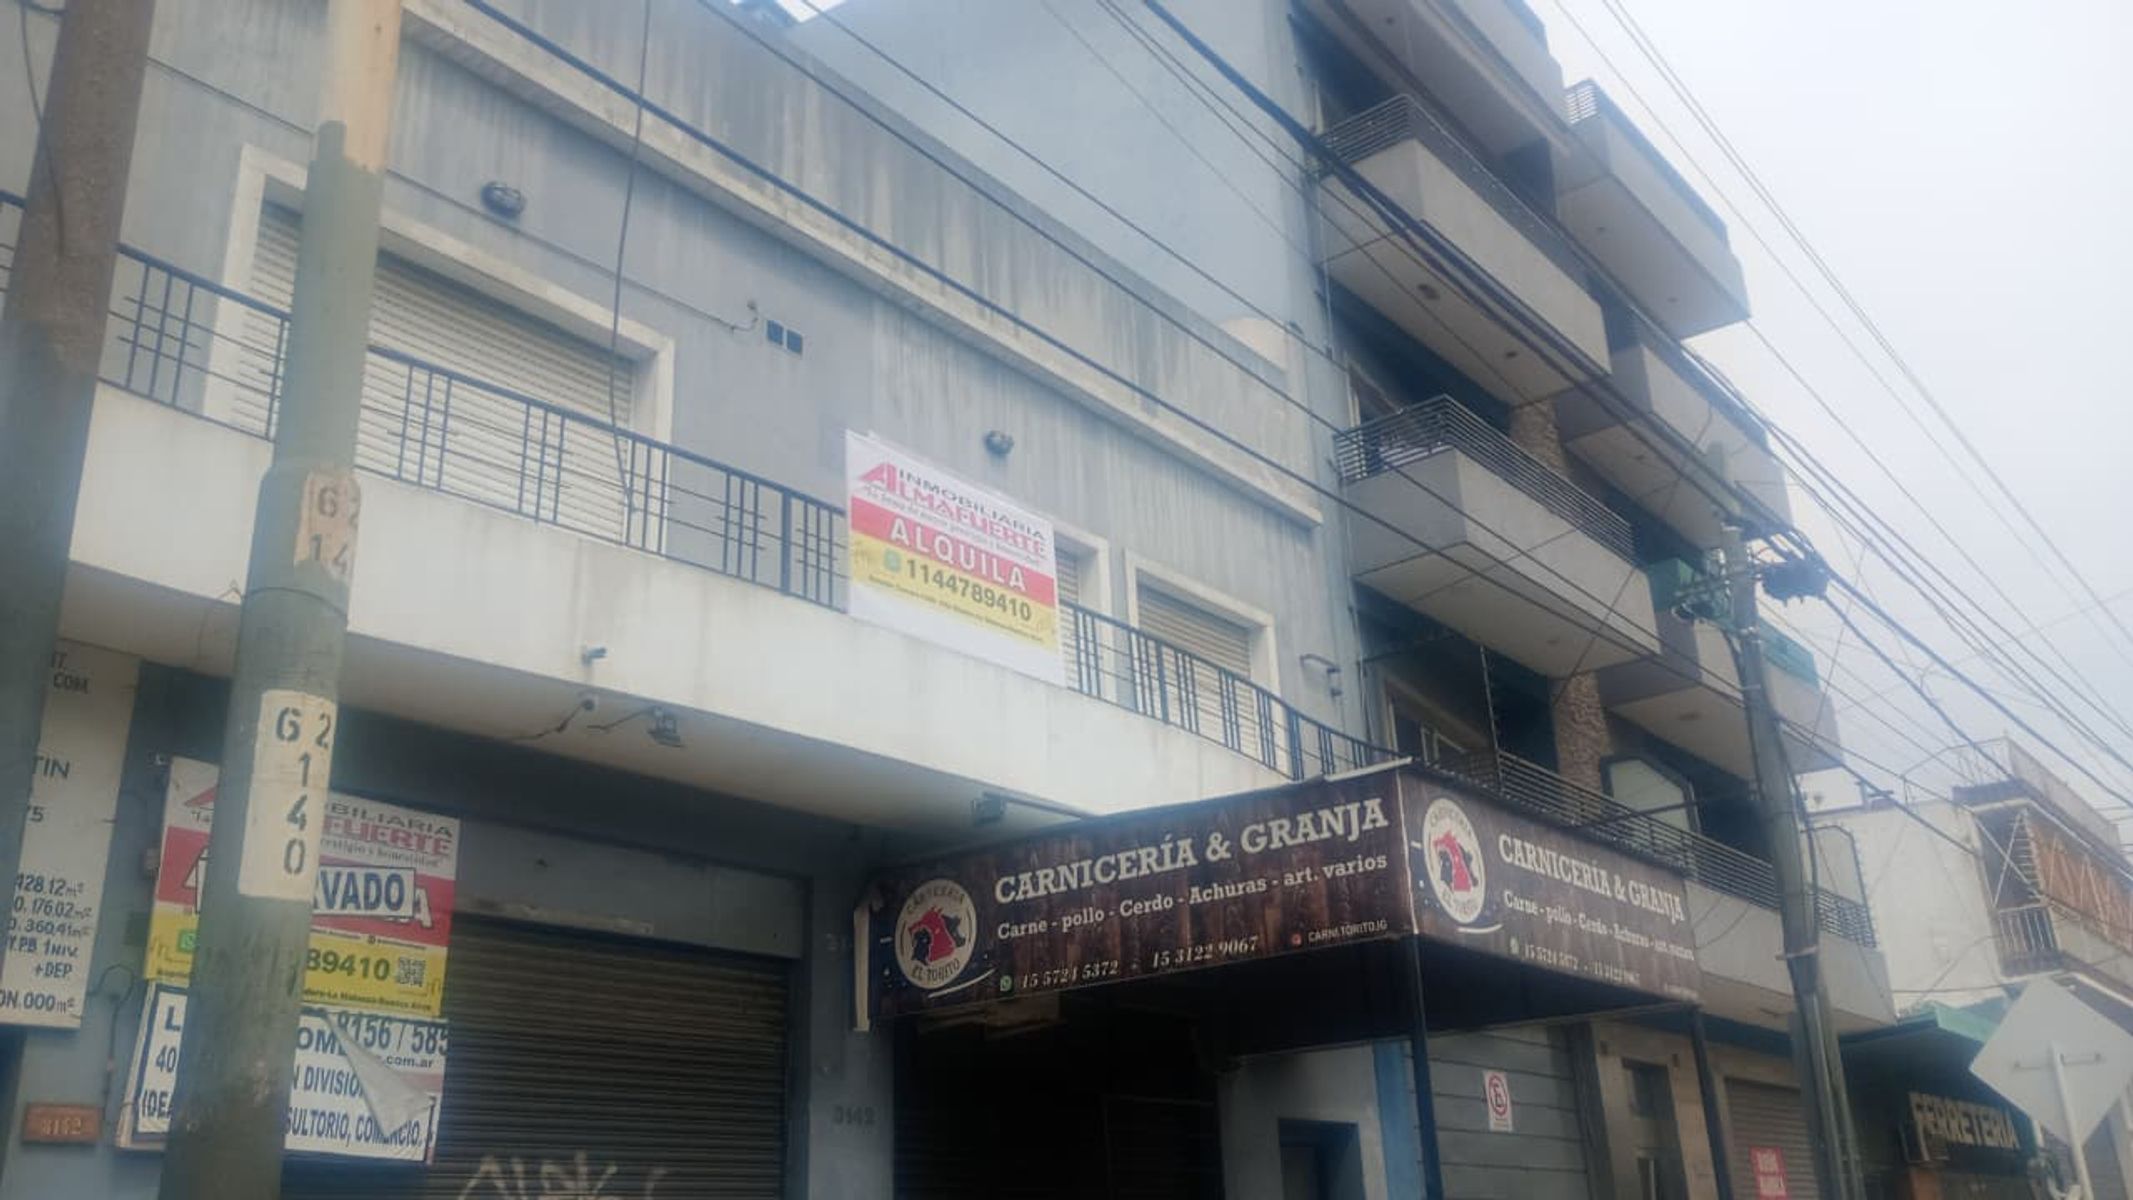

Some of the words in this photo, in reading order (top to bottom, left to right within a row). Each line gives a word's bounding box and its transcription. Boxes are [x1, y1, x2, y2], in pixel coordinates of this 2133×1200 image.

[858, 462, 1047, 561] ALMAFUERTE
[899, 468, 1045, 541] INMOBILIARIA
[889, 516, 1027, 592] ALQUILA
[906, 558, 1032, 622] 1144789410
[323, 802, 454, 838] BILIARIA
[995, 833, 1198, 904] CARNICERÍA
[1204, 832, 1233, 863] &
[1240, 798, 1389, 855] GRANJA
[996, 919, 1048, 942] Carne
[1061, 906, 1105, 933] pollo
[1119, 893, 1174, 919] Cerdo
[1188, 878, 1268, 906] Achuras
[1283, 867, 1319, 889] art.
[1322, 853, 1388, 879] varios
[1613, 873, 1628, 903] &
[1628, 879, 1686, 925] GRANJA
[1081, 959, 1120, 980] 5372
[1152, 952, 1170, 969] 15
